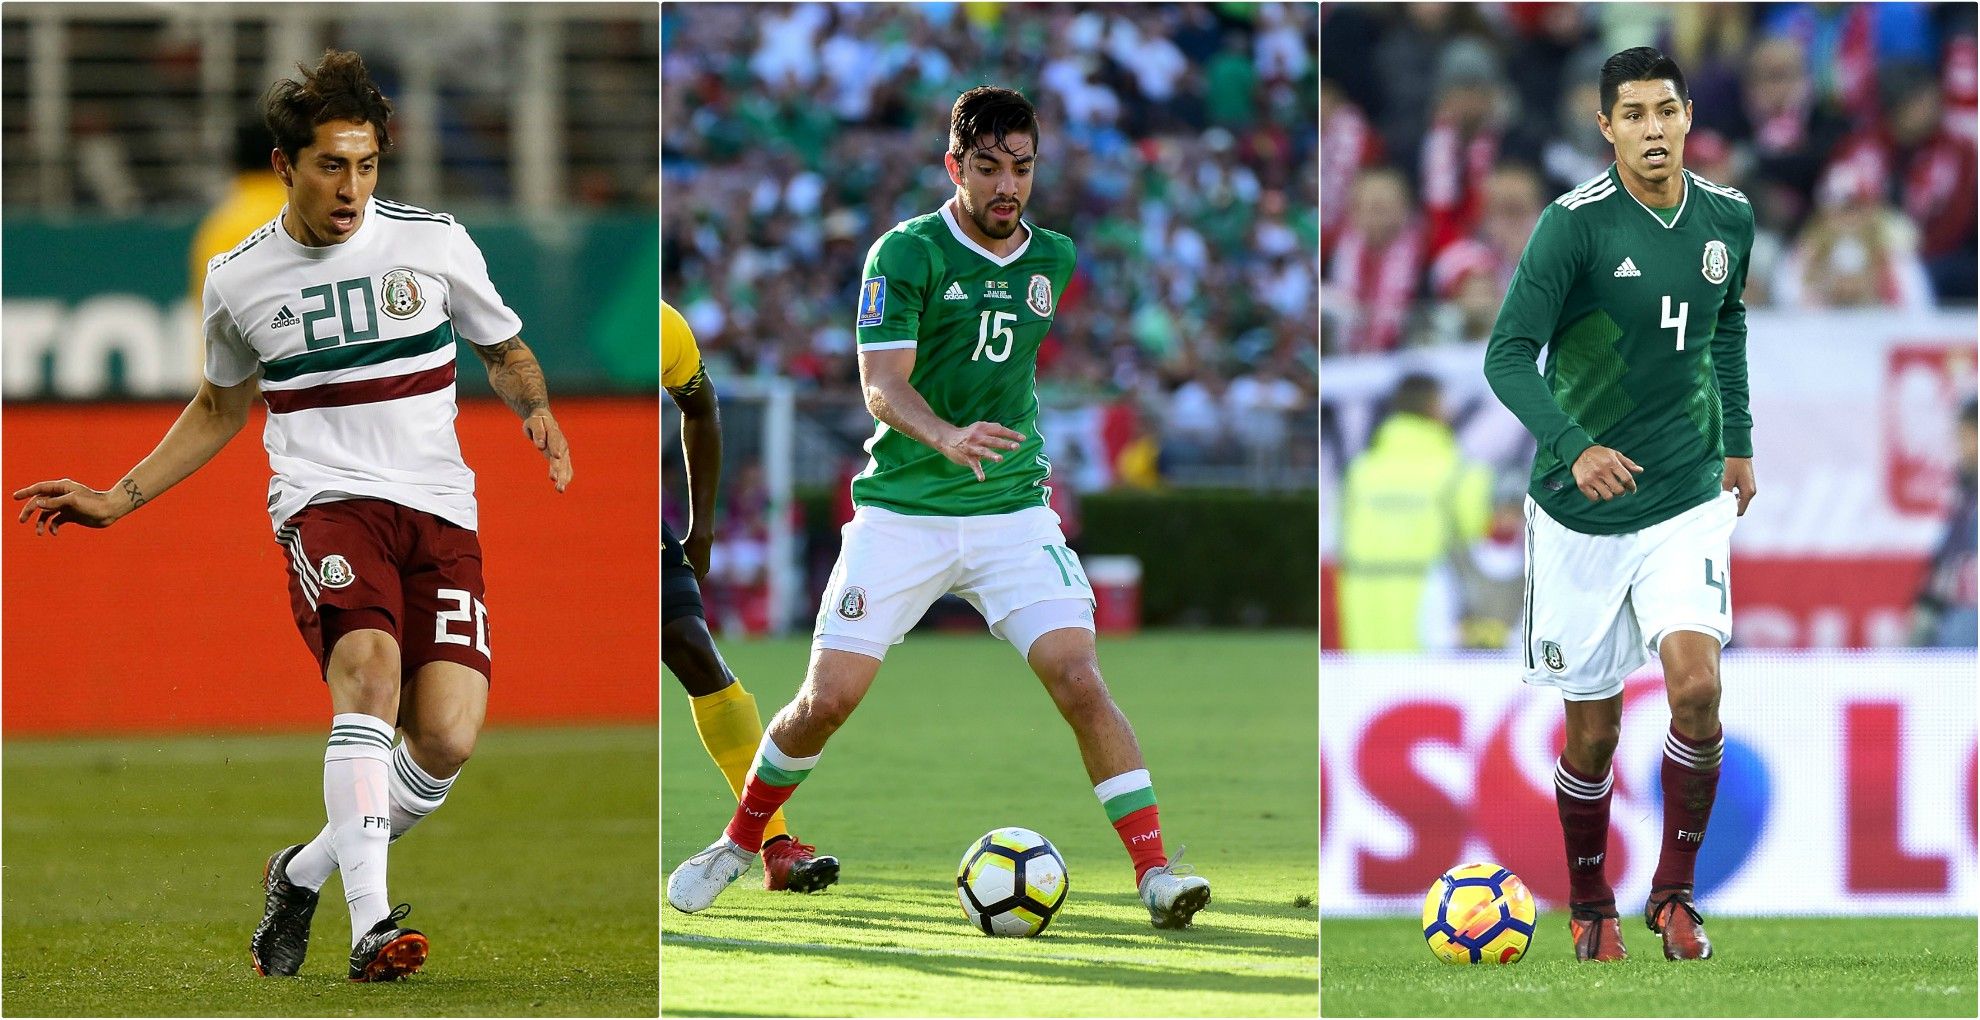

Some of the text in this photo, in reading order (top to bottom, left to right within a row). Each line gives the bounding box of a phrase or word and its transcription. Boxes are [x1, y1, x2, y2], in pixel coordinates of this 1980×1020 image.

[1613, 269, 1642, 278] adidas
[270, 317, 301, 330] adidas
[301, 276, 380, 351] 20
[1660, 295, 1689, 351] 4
[971, 310, 1017, 363] 15
[1705, 557, 1727, 615] 4
[1131, 829, 1161, 845] FMF
[1578, 852, 1604, 866] FMF
